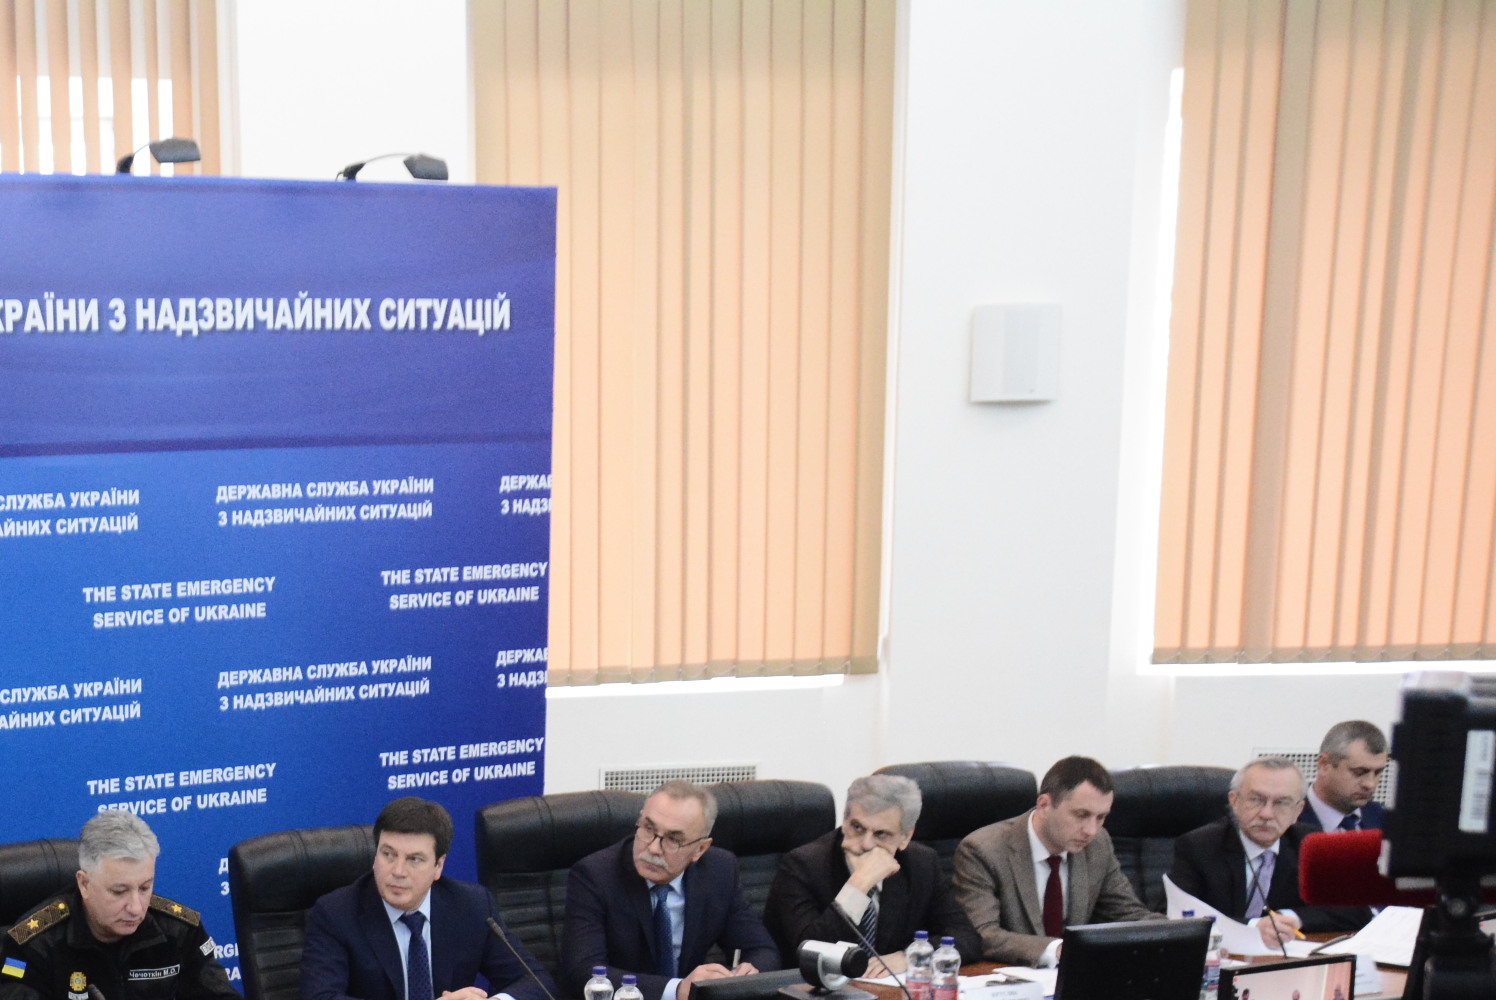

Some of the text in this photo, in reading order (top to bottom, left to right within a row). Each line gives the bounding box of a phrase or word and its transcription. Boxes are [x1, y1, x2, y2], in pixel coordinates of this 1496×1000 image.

[108, 297, 127, 332] З
[135, 290, 372, 337] НАДЗВИЧАЙНИХ
[378, 291, 511, 337] СИТУАЦІЙ
[69, 487, 141, 509] УКРАЇНИ
[215, 475, 435, 505] ДЕРЖАВНА СЛУЖБА УКРАЇНИ
[55, 511, 139, 536] СИТУАЦІЙ
[217, 499, 433, 528] З НАДЗВИЧАЙНИХ СИТУАЦІЙ
[380, 561, 548, 587] THE STATE EMERGENCY
[81, 575, 276, 604] THE STATE EMERGENCY
[388, 586, 538, 611] SERVICE OF UKRAINE
[92, 601, 267, 630] SERVICE OF UKRAINE
[216, 654, 433, 690] ДЕРЖАВНА СЛУЖБА УКРАЇНИ
[72, 676, 143, 700] УКРАЇНИ
[219, 676, 431, 712] З НАДЗВИЧАЙНИХ СИТУАЦІЙ
[58, 700, 142, 726] СИТУАЦІЙ
[378, 737, 544, 768] THE STATE EMERGENCY
[86, 762, 277, 796] THE STATE EMERGENCY
[387, 761, 535, 791] SERVICE OF UKRAINE
[171, 796, 193, 812] OF
[197, 788, 267, 810] UKRAINE
